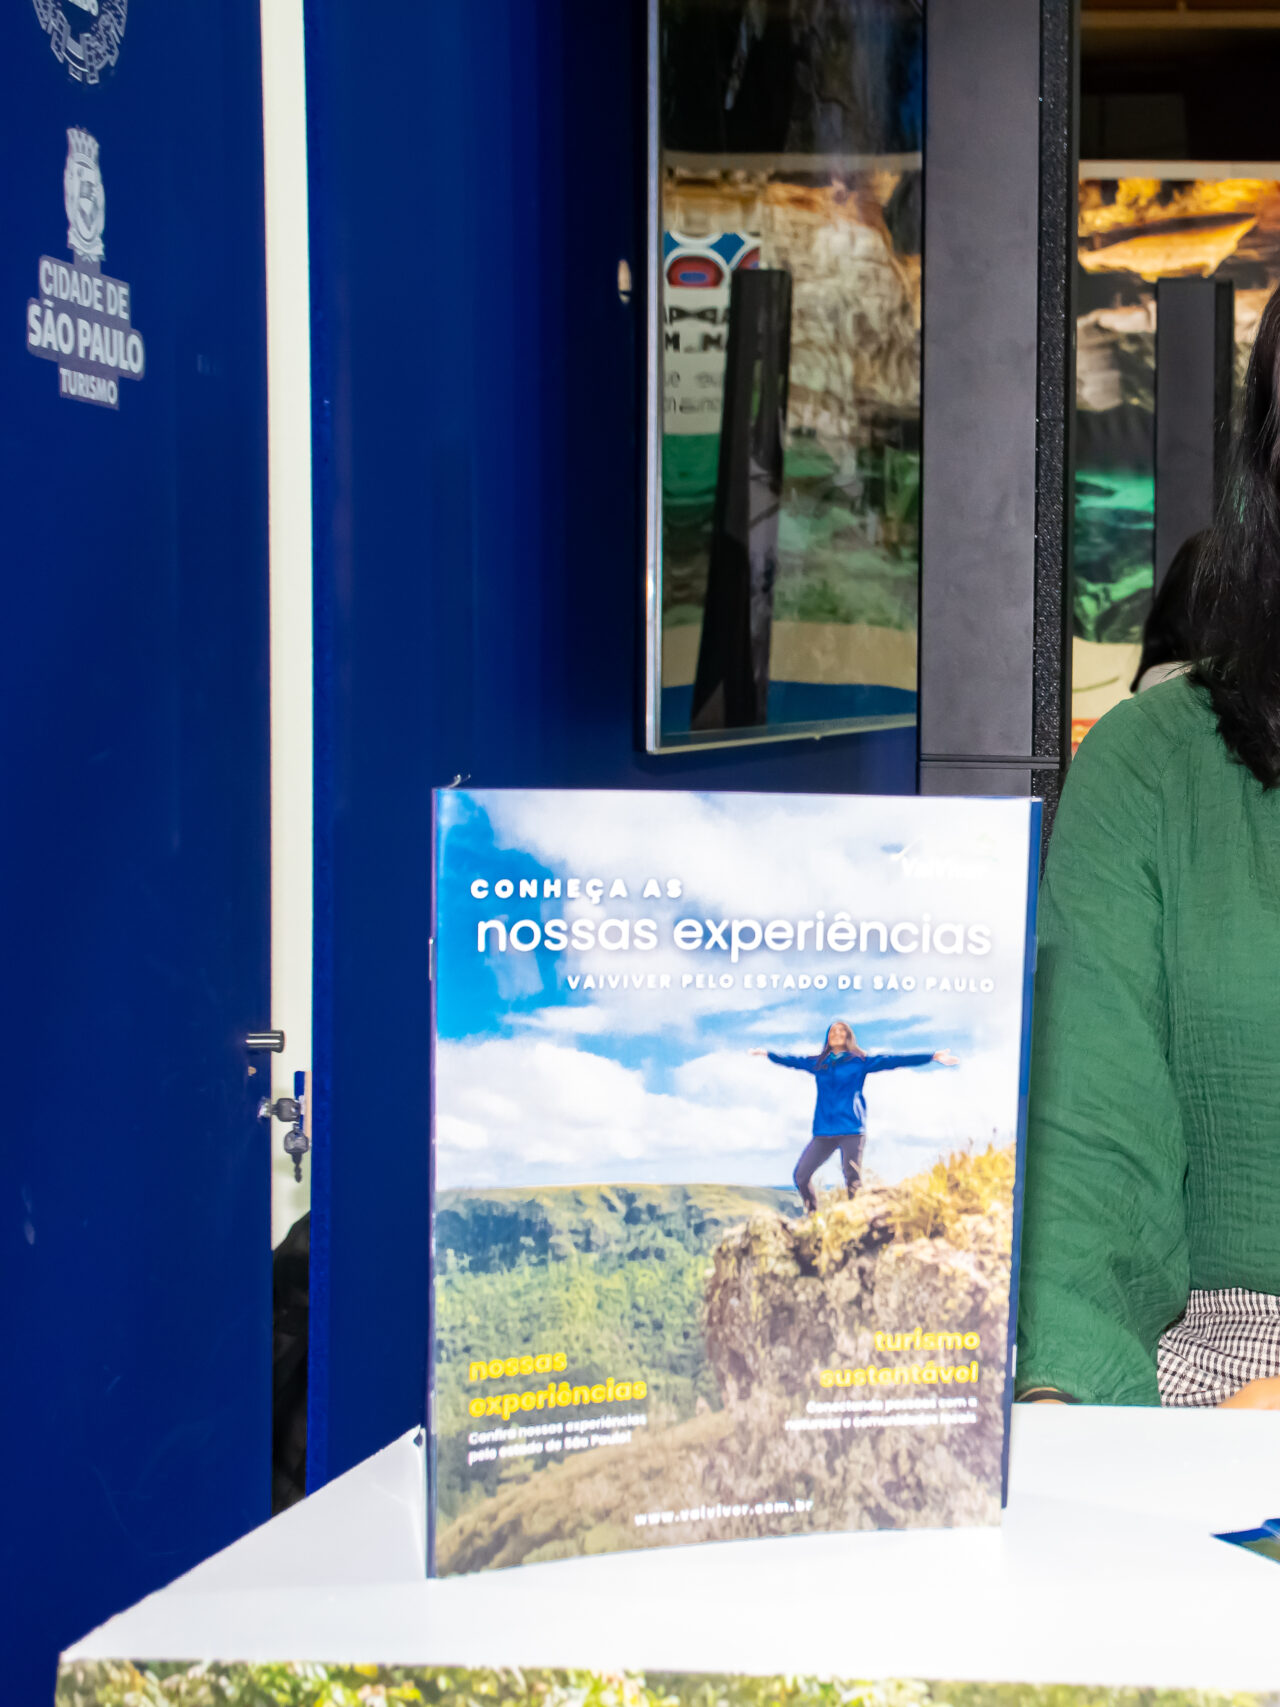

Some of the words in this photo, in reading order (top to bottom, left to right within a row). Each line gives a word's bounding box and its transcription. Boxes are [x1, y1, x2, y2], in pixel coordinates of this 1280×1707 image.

[40, 260, 104, 312] CIDADE
[106, 281, 130, 320] DE
[28, 299, 75, 355] SÃO
[77, 318, 144, 374] PAULO
[60, 368, 118, 405] TURISMO
[470, 878, 628, 905] CONHEÇA
[642, 878, 683, 899] AS
[477, 918, 659, 953] nossas
[673, 910, 993, 964] experiências
[567, 974, 671, 990] VAIVIVER
[681, 974, 734, 989] PELO
[743, 974, 829, 990] ESTADO
[838, 974, 863, 991] DE
[873, 973, 917, 992] SÃO
[926, 978, 995, 993] PAULO
[873, 1327, 981, 1352] turismo
[468, 1352, 568, 1382] nossas
[819, 1360, 979, 1388] sustentável
[468, 1377, 648, 1421] experiências
